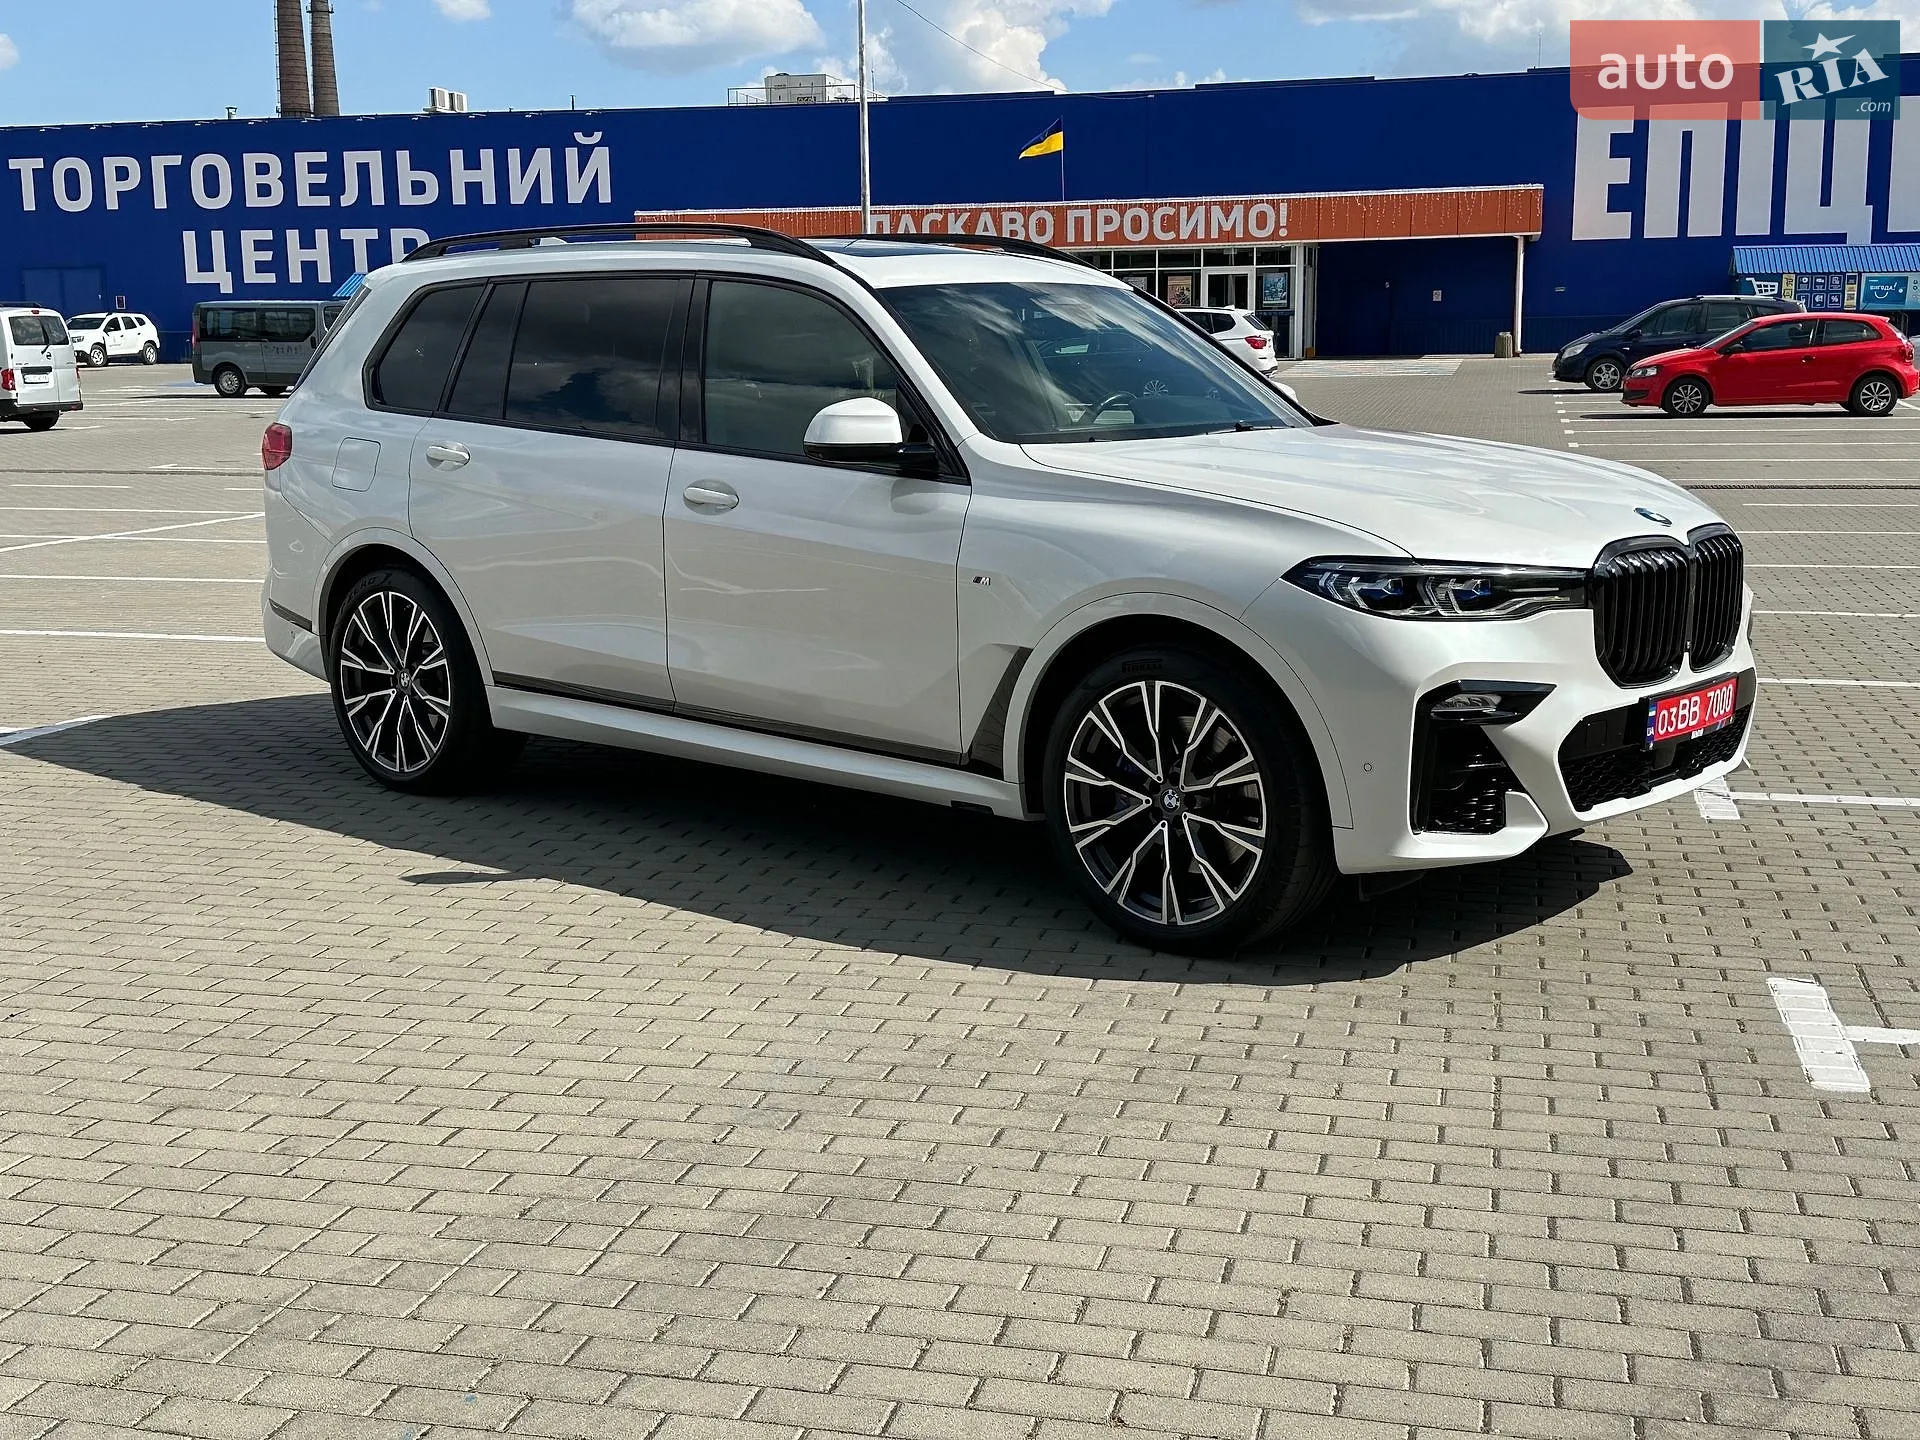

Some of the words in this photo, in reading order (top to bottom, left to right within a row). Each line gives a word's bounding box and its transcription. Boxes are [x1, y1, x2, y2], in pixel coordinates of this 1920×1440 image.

[8, 131, 612, 212] ТОРГОВЕЛЬНИЙ
[1066, 202, 1288, 242] ПРОСИМО!
[1706, 684, 1733, 721] 7000
